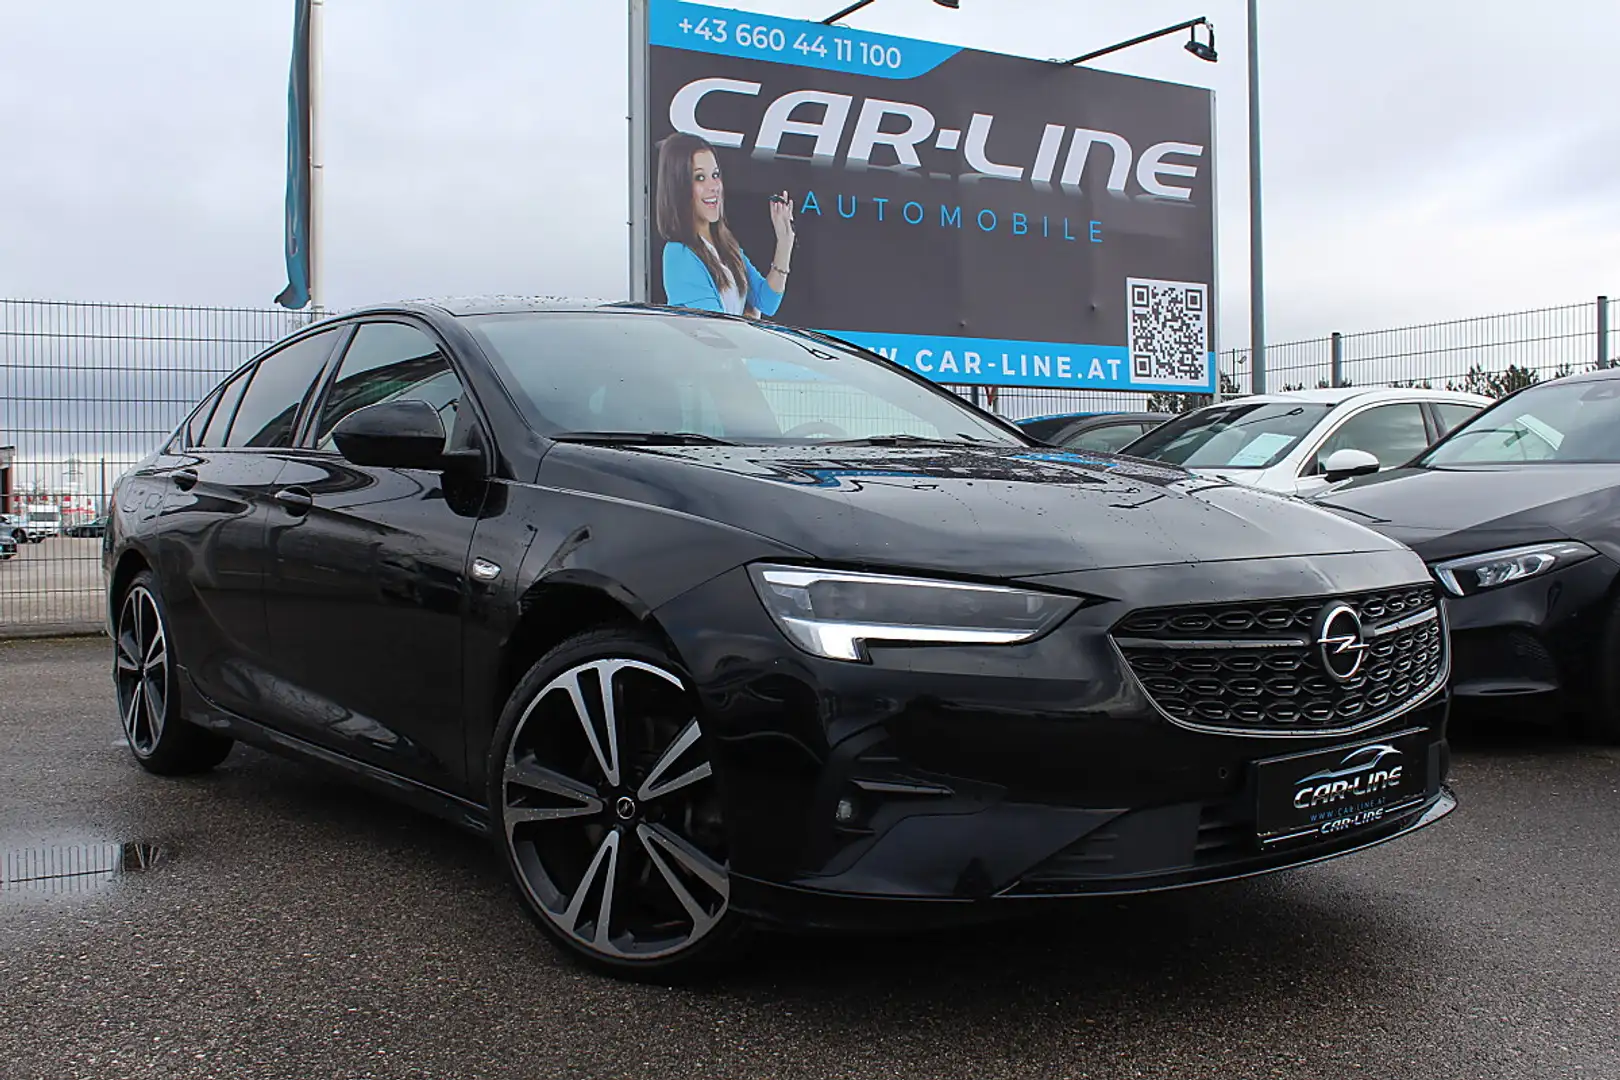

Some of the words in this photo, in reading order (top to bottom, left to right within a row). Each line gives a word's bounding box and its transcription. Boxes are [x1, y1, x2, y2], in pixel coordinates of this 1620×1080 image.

[678, 17, 728, 43] +43
[735, 24, 786, 51] 660
[793, 33, 828, 58] 44
[834, 38, 852, 62] 11
[859, 42, 902, 69] 100
[801, 191, 1104, 243] AUTOMOBILE
